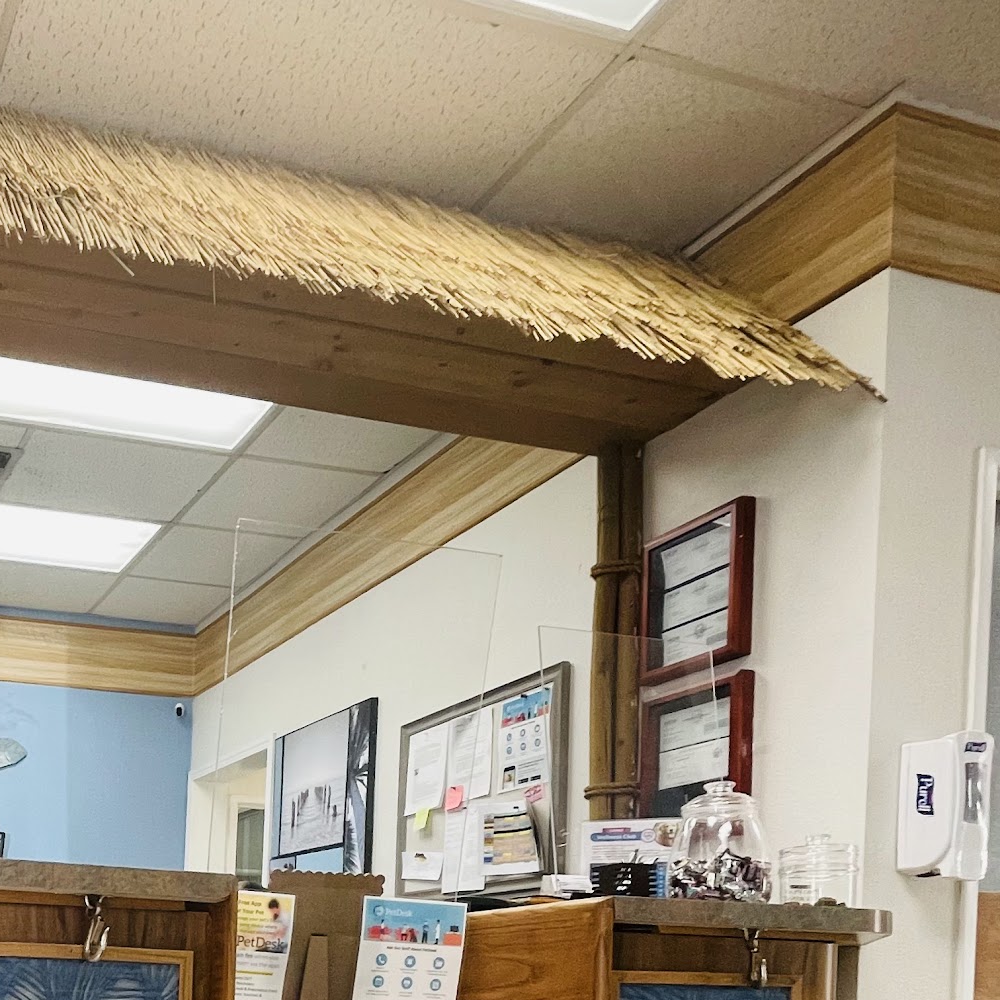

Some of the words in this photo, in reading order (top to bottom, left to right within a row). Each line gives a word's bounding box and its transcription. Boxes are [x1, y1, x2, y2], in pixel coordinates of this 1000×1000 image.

[917, 776, 934, 813] Purell
[385, 907, 412, 917] PetDesk
[236, 935, 285, 950] PetDesk
